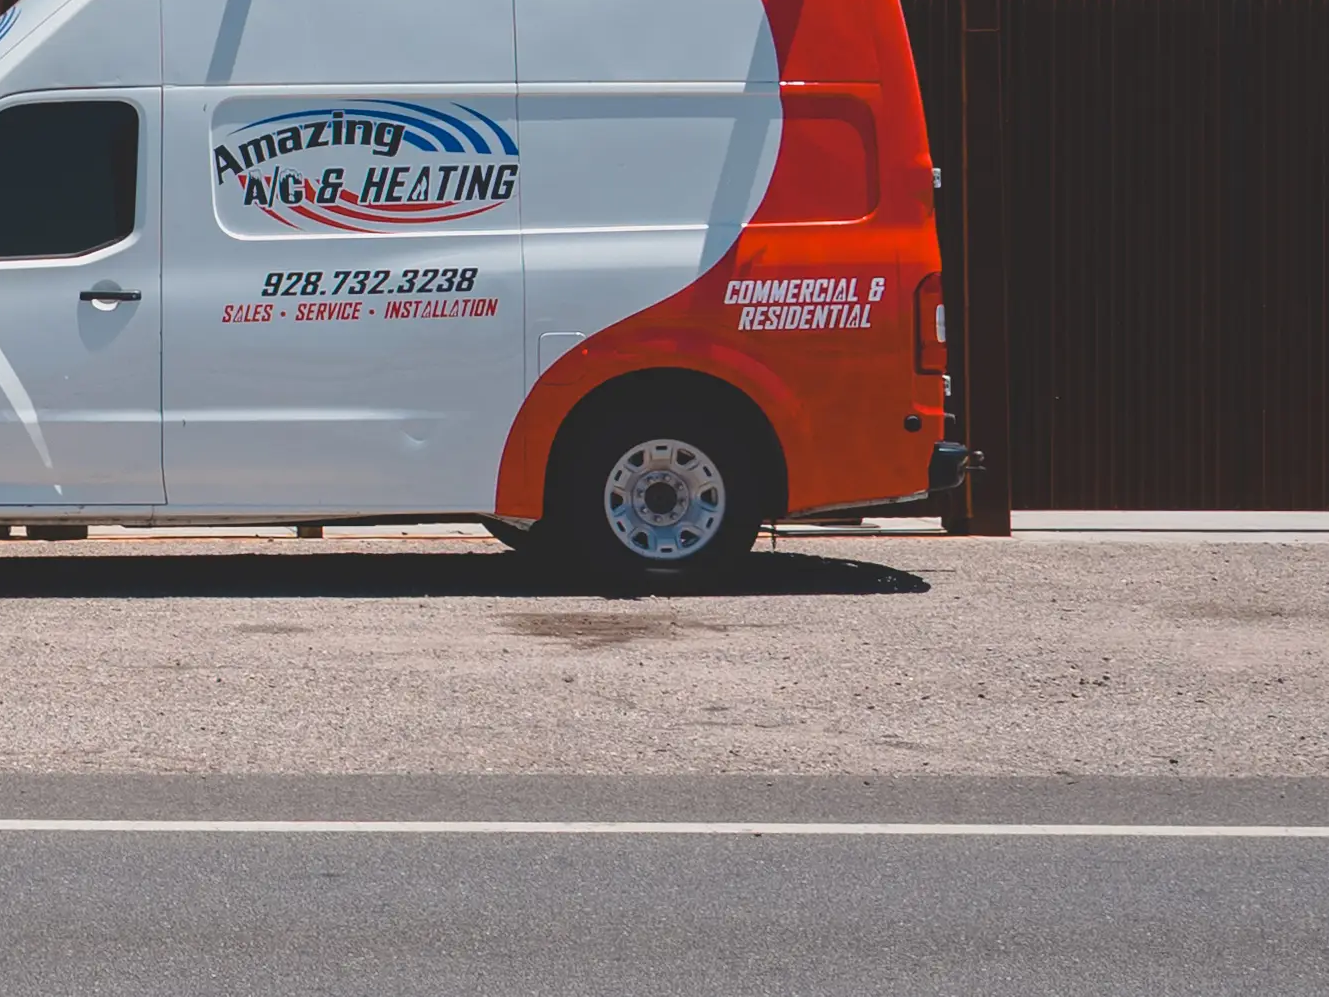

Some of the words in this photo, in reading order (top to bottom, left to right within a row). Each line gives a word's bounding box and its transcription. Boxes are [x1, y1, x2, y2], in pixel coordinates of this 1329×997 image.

[213, 110, 406, 186] Amazing
[243, 166, 304, 207] A/C
[315, 167, 345, 204] &
[358, 164, 519, 203] HEATING
[260, 267, 479, 297] 928.732.3238
[723, 277, 859, 305] COMMERCIAL
[867, 277, 886, 302] &
[221, 304, 274, 323] SALES
[295, 301, 362, 321] SERVICE
[384, 298, 499, 319] INSTALLATION
[737, 304, 872, 331] RESIDENTIAL
